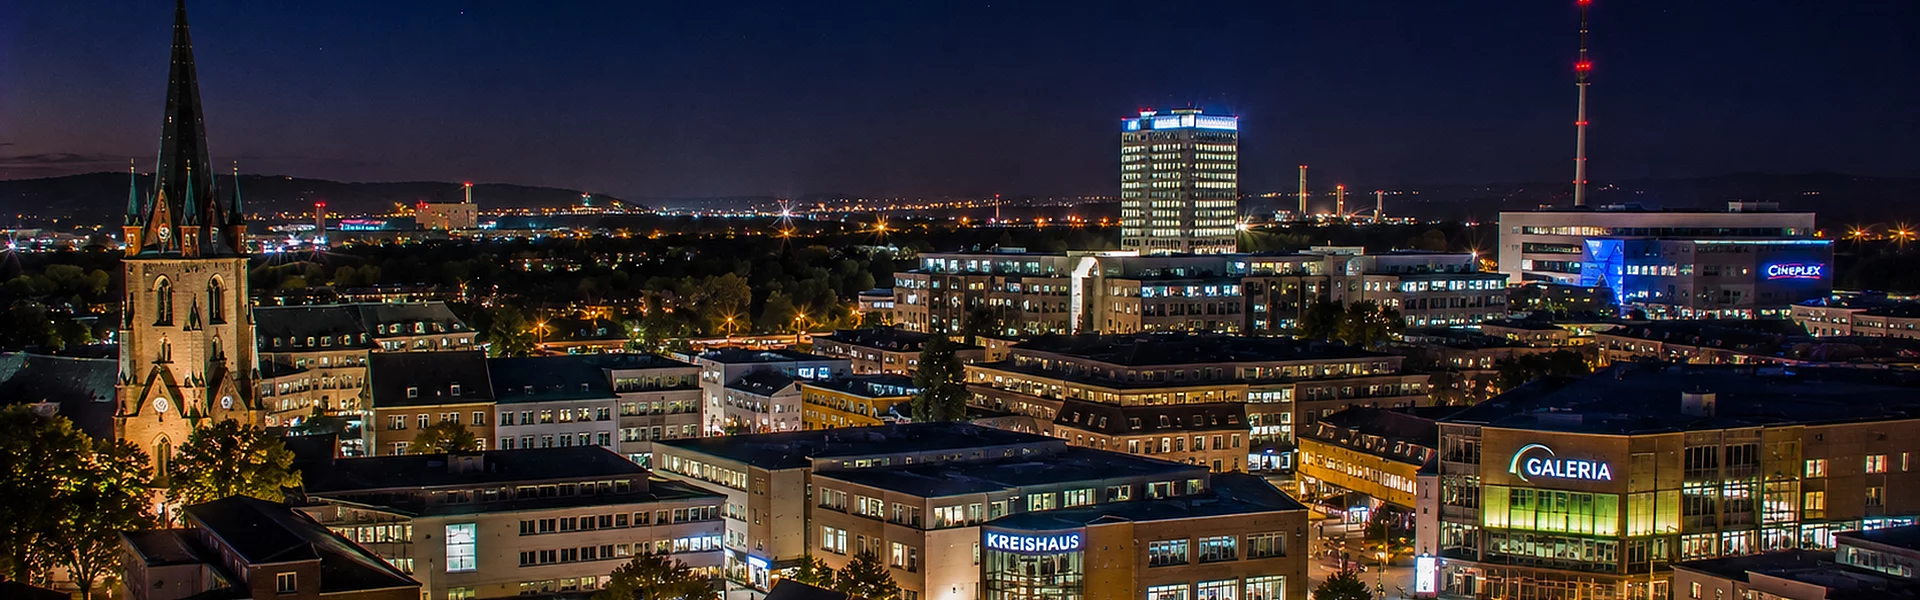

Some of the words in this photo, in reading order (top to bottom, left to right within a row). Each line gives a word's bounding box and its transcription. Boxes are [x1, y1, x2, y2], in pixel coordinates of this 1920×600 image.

[1768, 264, 1821, 276] CINEPLEX
[1527, 458, 1612, 480] GALERIA
[987, 532, 1079, 551] KREISHAUS
